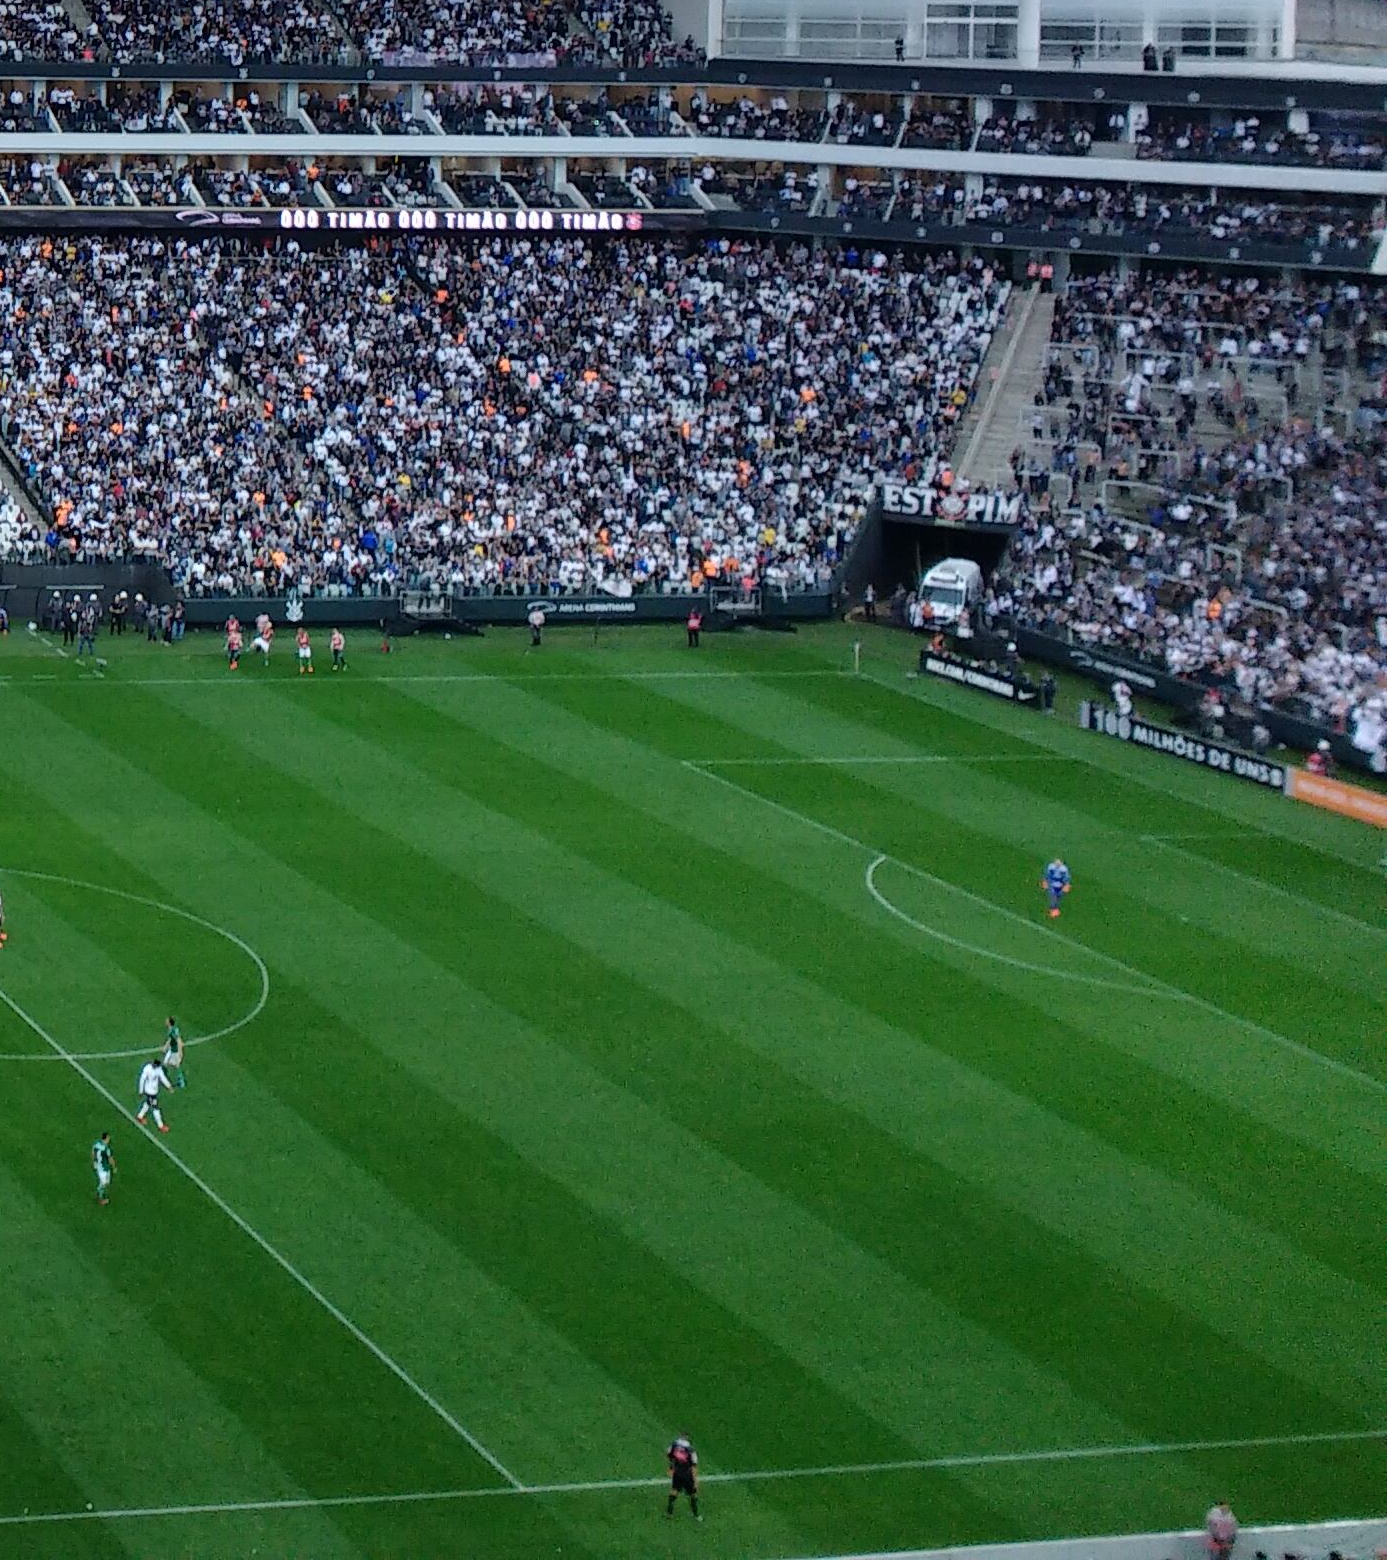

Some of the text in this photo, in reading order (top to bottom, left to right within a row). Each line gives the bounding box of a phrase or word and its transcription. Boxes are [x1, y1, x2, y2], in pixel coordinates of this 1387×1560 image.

[328, 210, 390, 228] TIMÃO
[445, 210, 507, 229] TIMÃO
[561, 211, 630, 230] TIMÃO
[1094, 709, 1132, 740] 100
[1133, 724, 1206, 763] MILHÕES
[1207, 747, 1231, 771] DE
